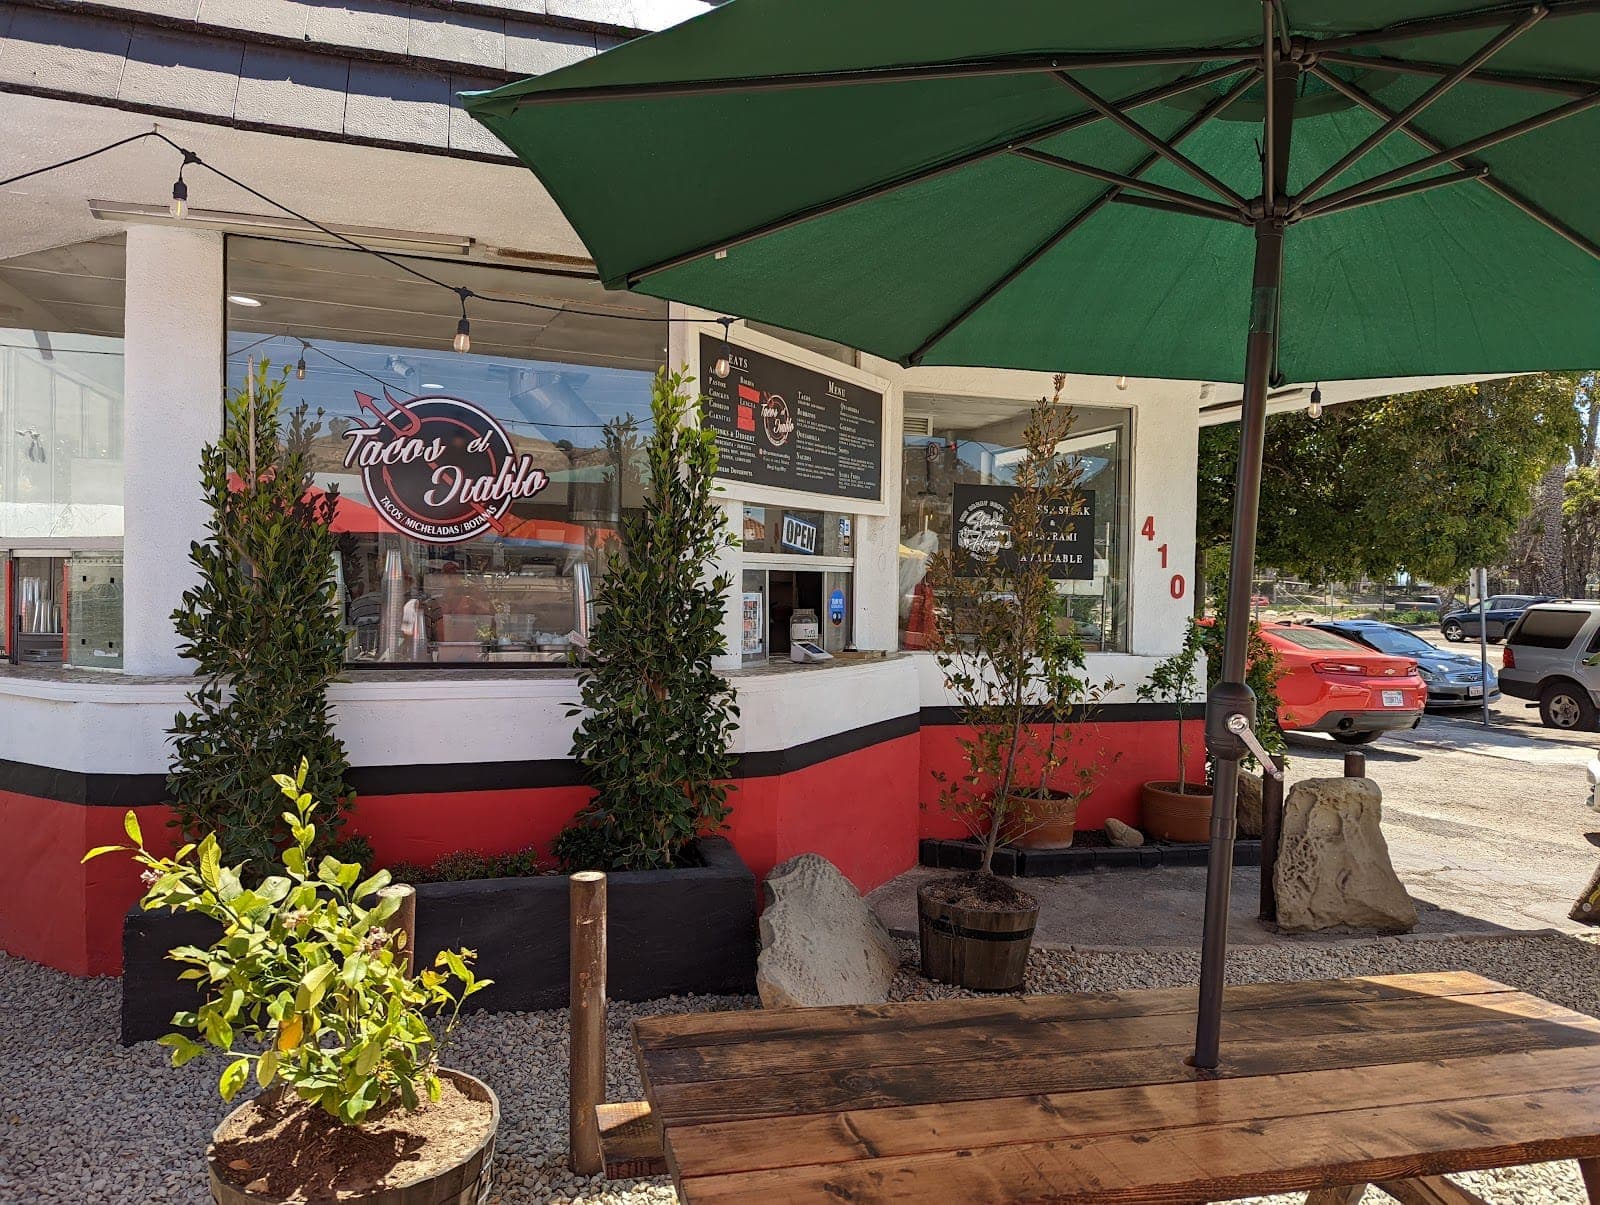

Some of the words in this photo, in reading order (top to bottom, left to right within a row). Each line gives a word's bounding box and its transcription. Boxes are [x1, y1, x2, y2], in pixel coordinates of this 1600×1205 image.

[727, 353, 749, 369] EATS
[342, 428, 446, 468] Tacos
[466, 430, 493, 453] el
[423, 454, 549, 507] Diablo
[380, 495, 404, 520] TACOS
[404, 518, 459, 535] MICHELADAS
[463, 504, 497, 531] BOTANAS
[786, 519, 815, 551] OPEN
